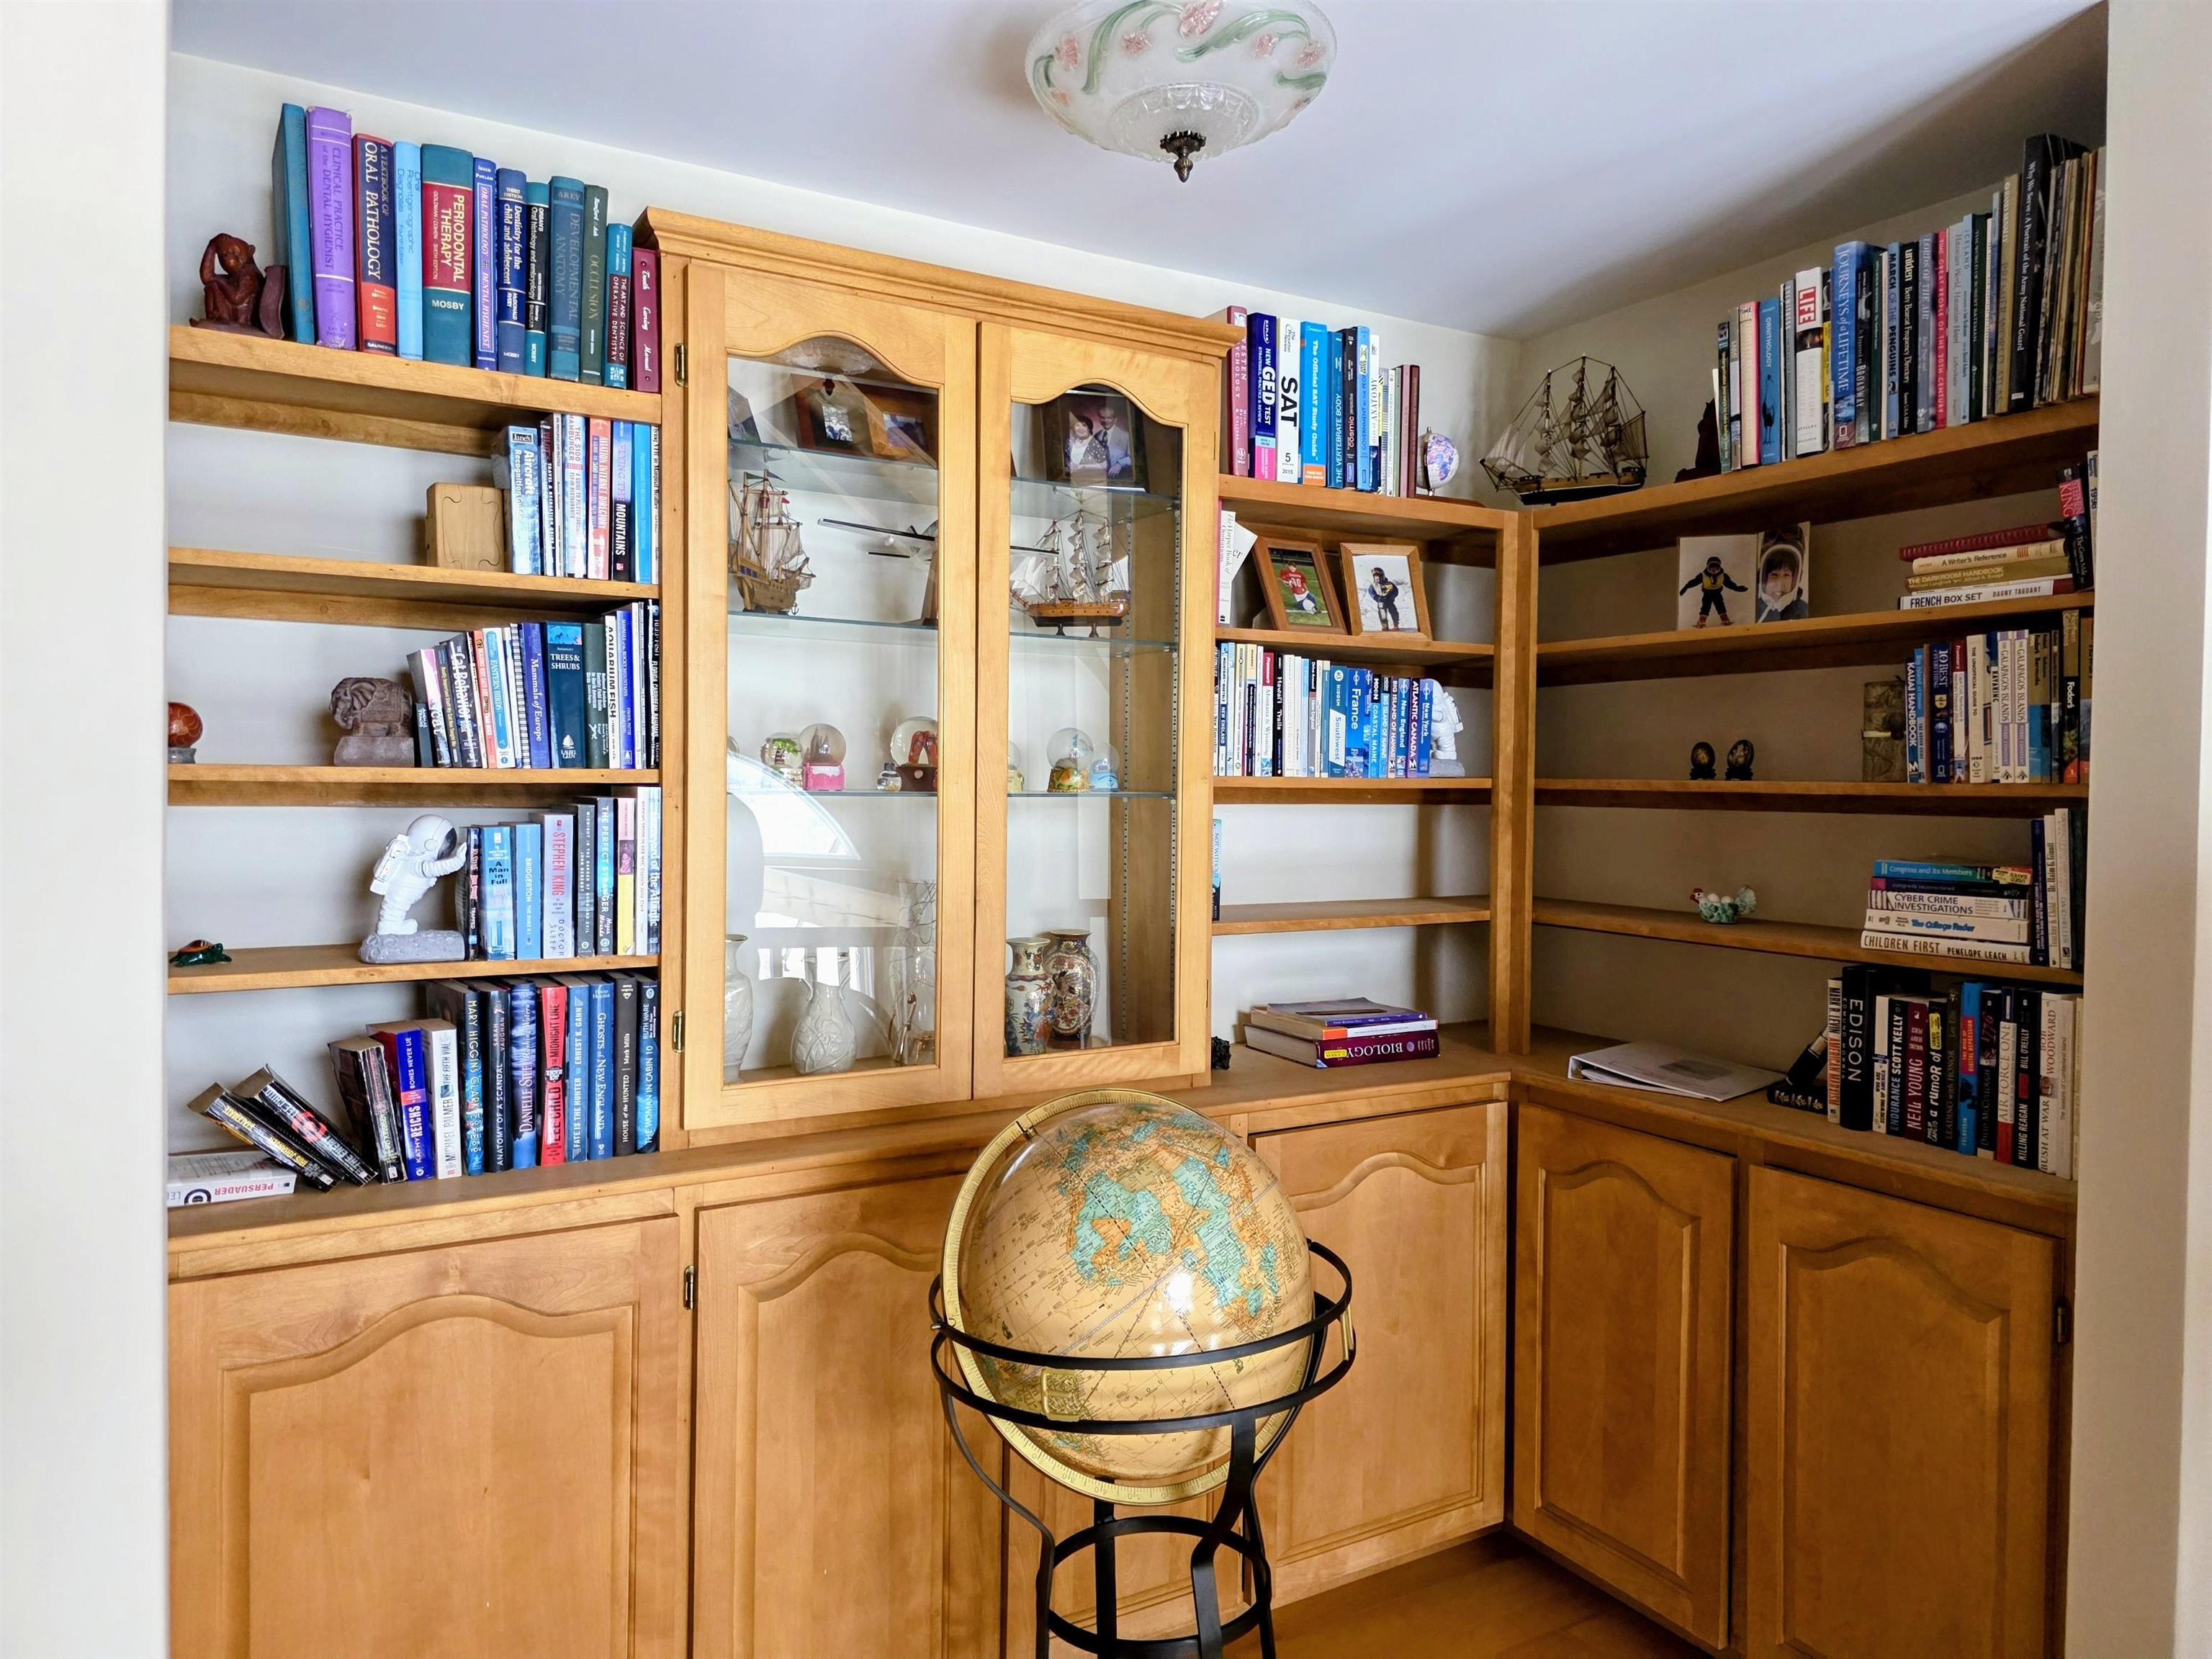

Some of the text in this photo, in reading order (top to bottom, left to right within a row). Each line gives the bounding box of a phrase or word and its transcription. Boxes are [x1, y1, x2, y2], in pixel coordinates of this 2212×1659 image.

[365, 142, 377, 182] ORAL
[504, 203, 513, 222] child
[557, 190, 580, 201] AREY
[366, 192, 381, 280] PATHOLOGY
[441, 208, 451, 267] THERAPY
[454, 195, 464, 282] PERIODONTAL
[556, 233, 566, 296] ANATOMY
[569, 212, 580, 320] DEVELOPMENTAL
[1923, 269, 1930, 281] OF
[588, 254, 600, 320] OCCLUSION
[1889, 292, 1896, 305] OF
[432, 300, 464, 310] MOSBY
[1799, 288, 1815, 324] LIFE
[1263, 366, 1276, 406] GED
[1281, 376, 1299, 428] SAT
[1856, 365, 1866, 408] BROADWAY
[524, 450, 535, 495] Aircraft
[1285, 453, 1291, 462] 5
[2059, 484, 2075, 518] KING
[616, 504, 626, 556] MOUNTAINS
[1921, 572, 1961, 584] DARKROOM
[1963, 566, 2004, 577] HANDBOOK
[1948, 556, 1972, 565] Writer's
[1974, 552, 2008, 562] Reference
[1910, 586, 2041, 609] FRENCH BOX SET DAGNY TAGGART
[531, 700, 540, 709] of
[1351, 688, 1361, 730] France
[1907, 662, 1917, 746] KAUAI HANDBOOK
[2067, 681, 2075, 709] Fodor's
[553, 832, 566, 871] STEPHEN
[552, 876, 565, 896] KING
[1895, 894, 1959, 905] CYBER CRIME
[1894, 903, 1974, 914] INVESTIGATIONS
[1864, 935, 2008, 961] CHILDREN FIRST PENELOPE LEACH
[1848, 999, 1863, 1082] EDISON
[1981, 1014, 1995, 1042] 1776
[2046, 1010, 2056, 1076] WOODWARD
[468, 1000, 480, 1112] MARY HIGGINS CLARK
[648, 1046, 654, 1057] 10
[1346, 1043, 1403, 1058] BIOLOGY
[2020, 1028, 2029, 1069] BILL O'REILLY
[1890, 1015, 1903, 1130] ENDURANCE SCOTT KELLY
[1999, 1024, 2011, 1122] AIR FORCE ONE
[645, 1089, 652, 1098] IN
[1907, 1058, 1923, 1130] NEIL YOUNG
[409, 1105, 423, 1138] REICHS
[2018, 1103, 2028, 1161] KILLING REAGAN
[2041, 1127, 2049, 1139] AT
[2040, 1142, 2049, 1171] BUSH
[215, 1183, 274, 1195] PERSUADER
